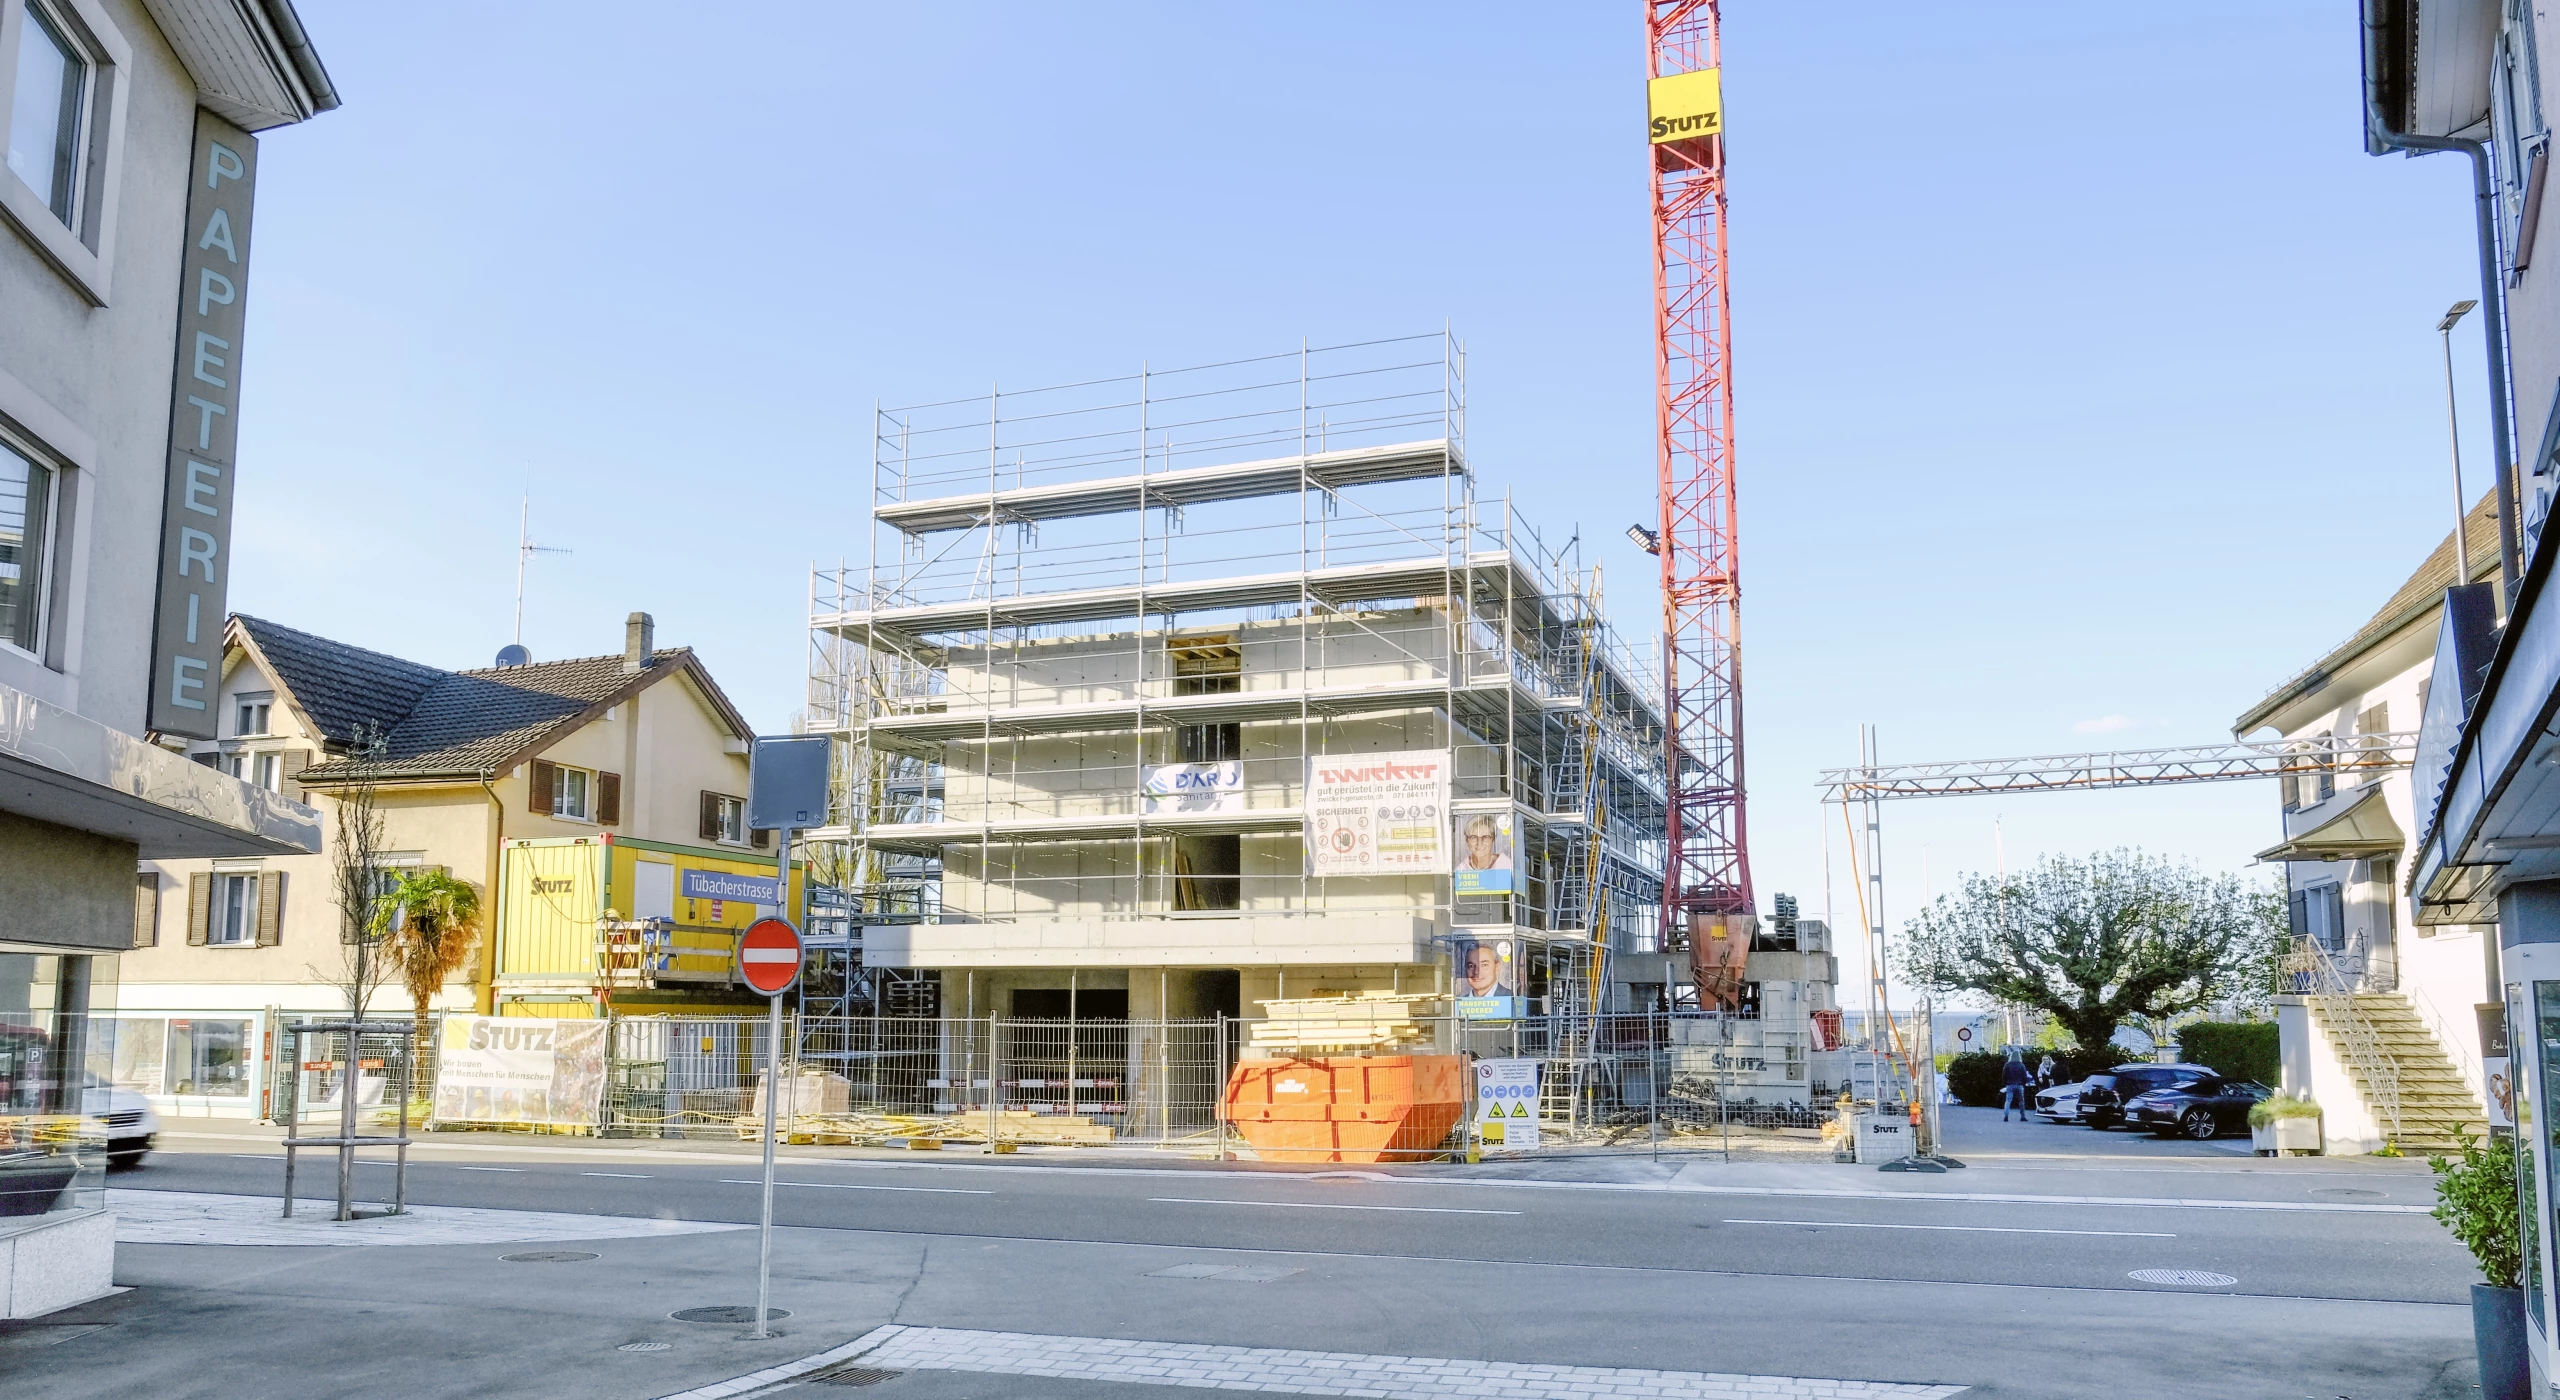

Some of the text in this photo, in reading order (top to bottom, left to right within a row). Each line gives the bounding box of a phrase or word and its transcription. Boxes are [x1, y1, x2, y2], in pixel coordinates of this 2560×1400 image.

[1651, 111, 1718, 138] STUTZ
[171, 140, 245, 711] PAPETERIE
[1317, 786, 1332, 797] gut
[1334, 784, 1372, 796] gerüstet
[1386, 783, 1400, 792] die
[1402, 781, 1438, 792] Zukunft
[1316, 806, 1368, 817] SICHERHEIT
[531, 877, 573, 896] STUTZ
[690, 874, 773, 899] Tübacherstrasse
[469, 1019, 555, 1052] STUTZ
[443, 1059, 482, 1068] Wir bauen
[456, 1070, 494, 1079] Menschen
[495, 1070, 506, 1079] für
[507, 1072, 551, 1081] Menschen
[1873, 1124, 1899, 1134] STUTZ
[1482, 1137, 1505, 1146] STUTZ
